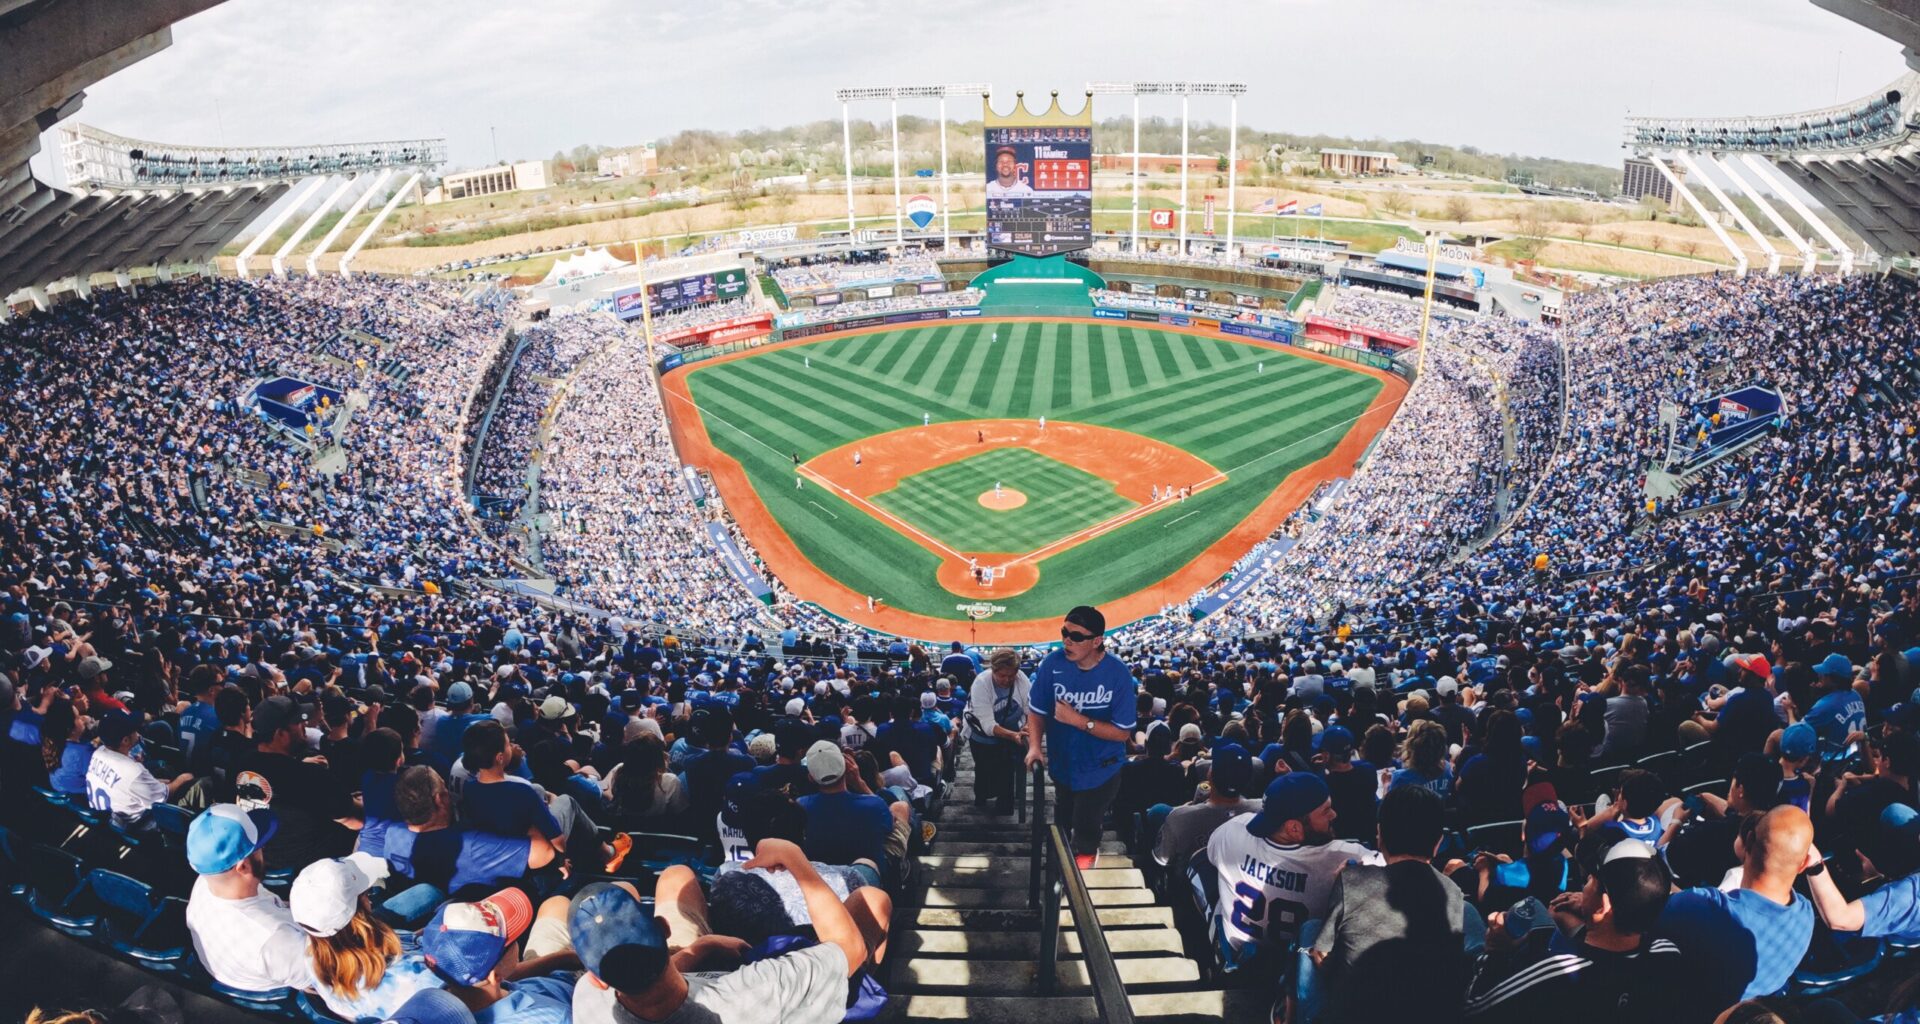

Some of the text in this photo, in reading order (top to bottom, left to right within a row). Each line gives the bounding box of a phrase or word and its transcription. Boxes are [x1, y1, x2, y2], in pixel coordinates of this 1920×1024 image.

[1034, 145, 1042, 158] 11
[754, 226, 796, 241] evergy
[1397, 237, 1471, 260] BLUE MOON
[1053, 683, 1113, 713] Royals
[181, 731, 196, 760] 7
[1240, 854, 1309, 893] JACKSON
